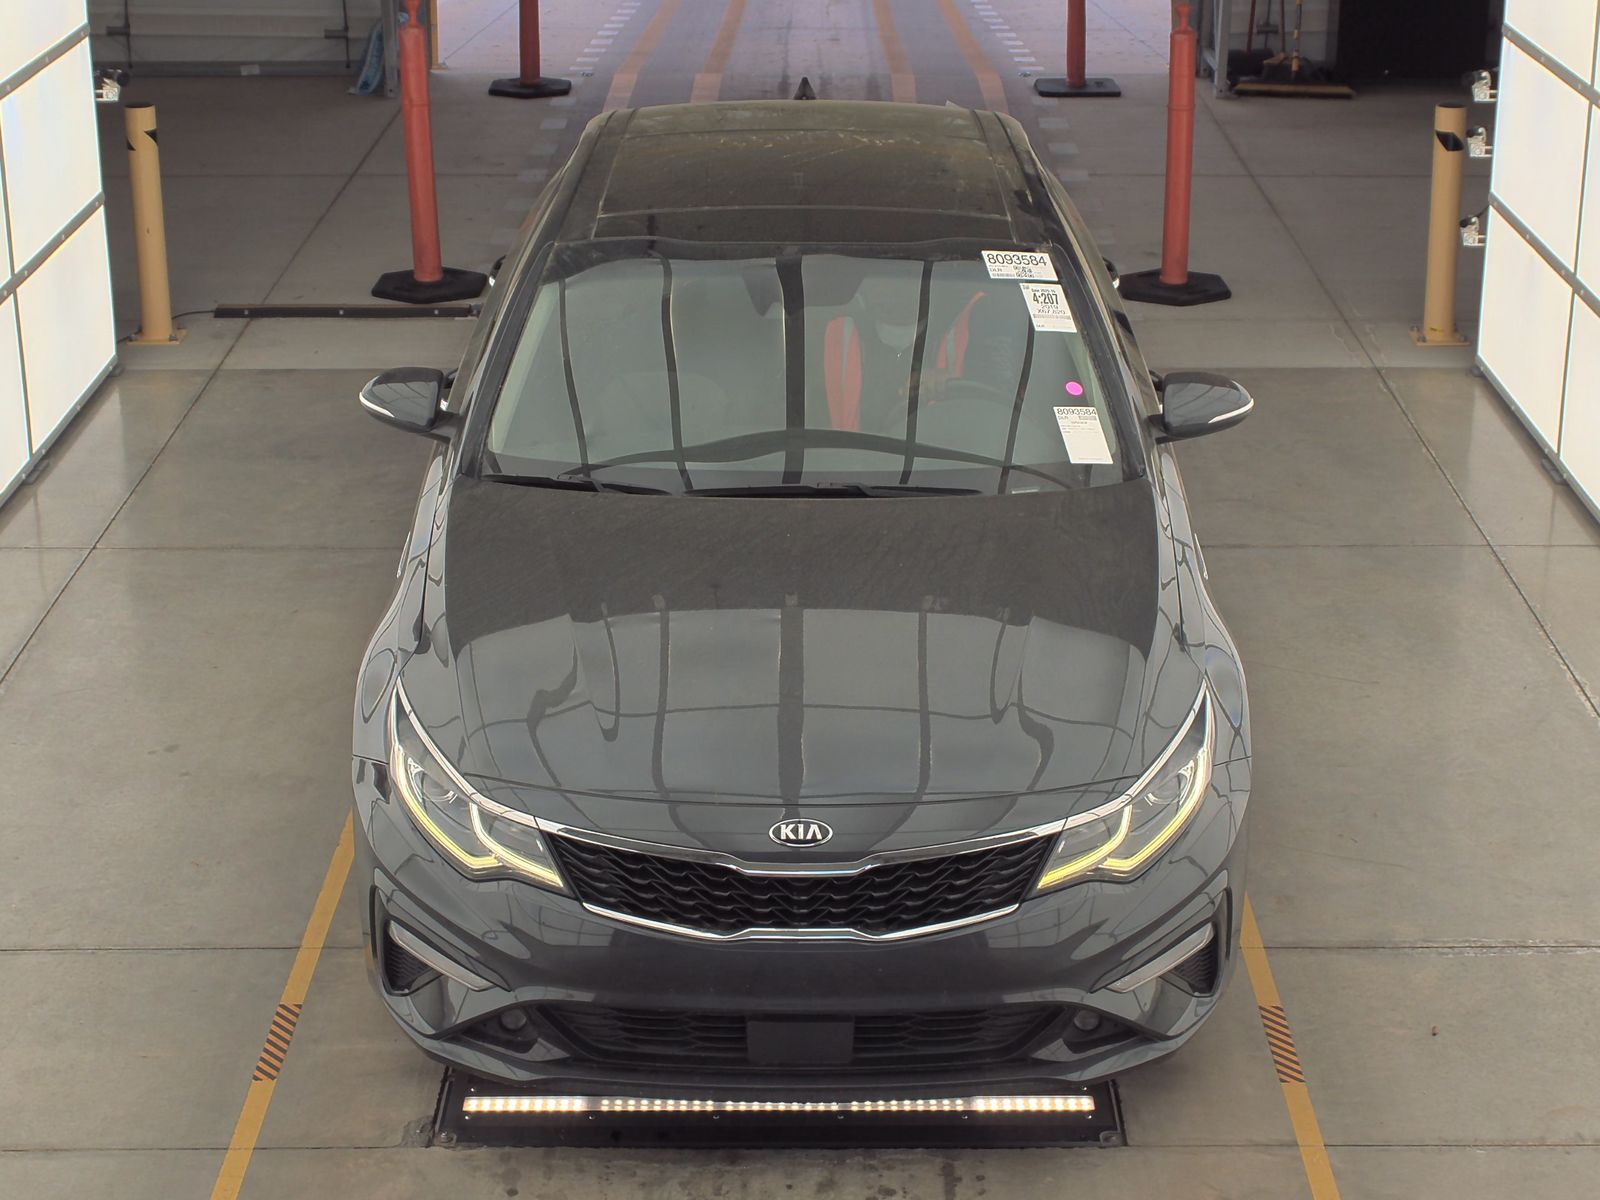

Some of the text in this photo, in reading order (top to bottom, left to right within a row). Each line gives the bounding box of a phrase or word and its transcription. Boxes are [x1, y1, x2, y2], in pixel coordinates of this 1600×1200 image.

[987, 253, 1047, 266] 8093584
[1056, 408, 1097, 416] 8093584
[780, 823, 823, 840] KIA
